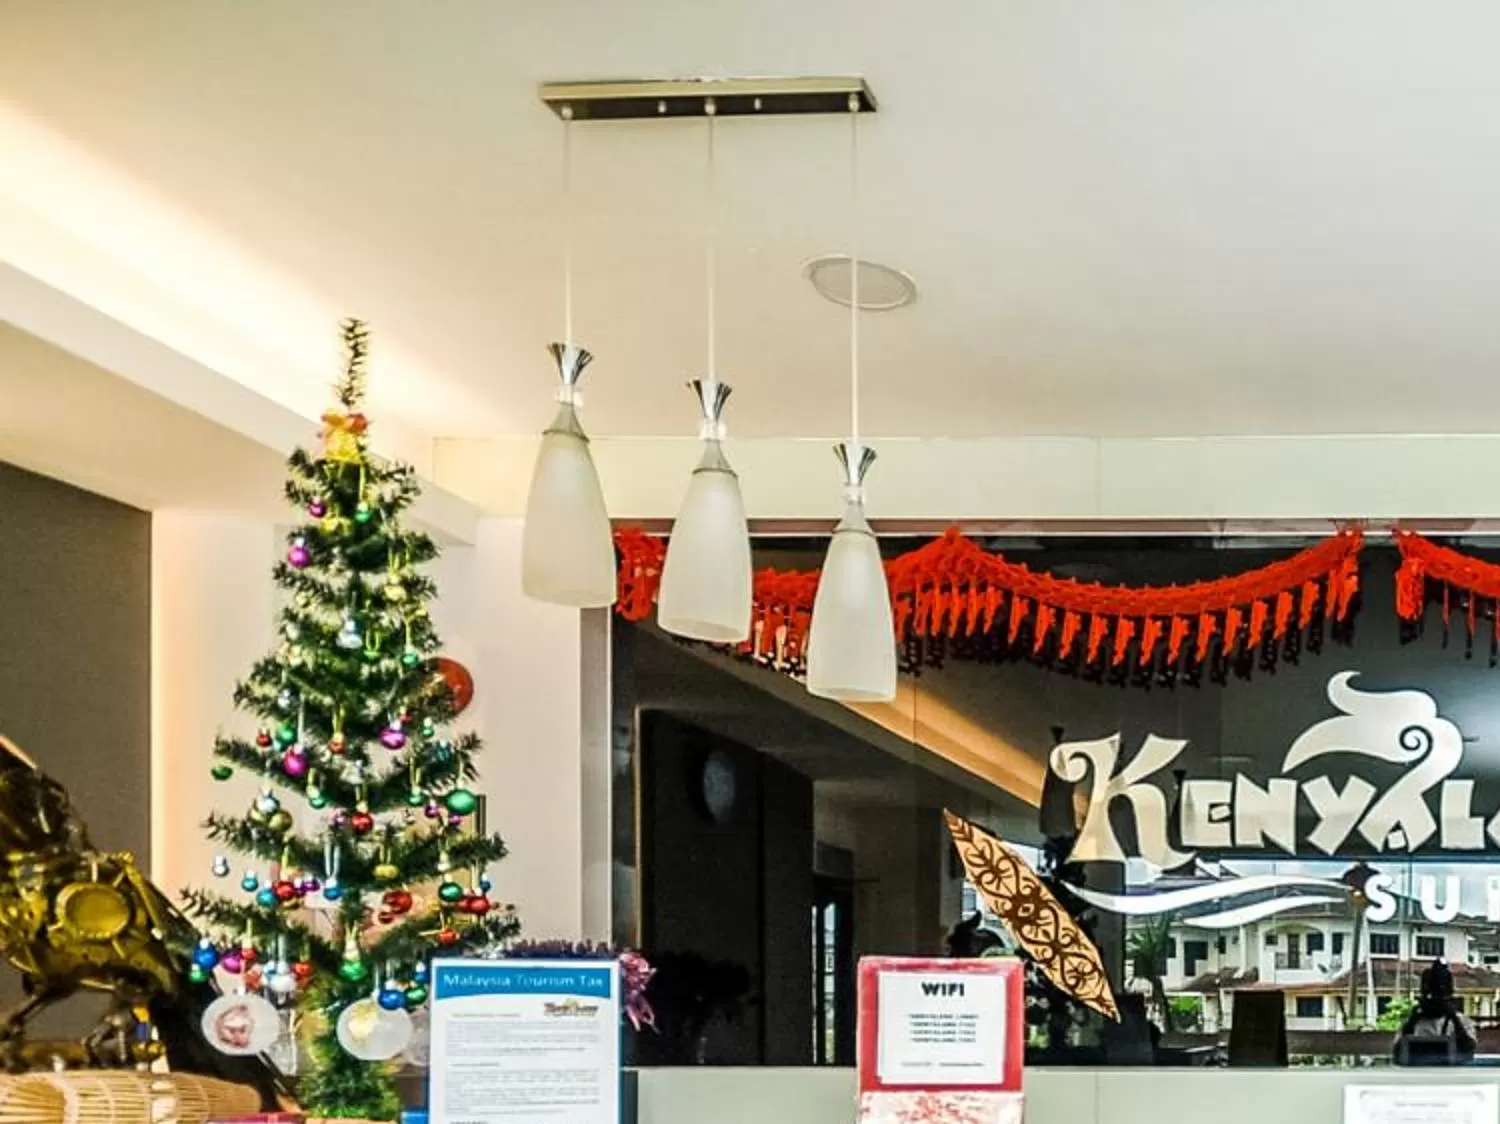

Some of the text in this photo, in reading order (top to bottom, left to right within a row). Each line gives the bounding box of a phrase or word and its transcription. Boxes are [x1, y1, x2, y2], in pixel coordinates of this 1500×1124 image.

[443, 974, 604, 988] Malaysia Tourism Tax
[921, 982, 965, 997] WIFI
